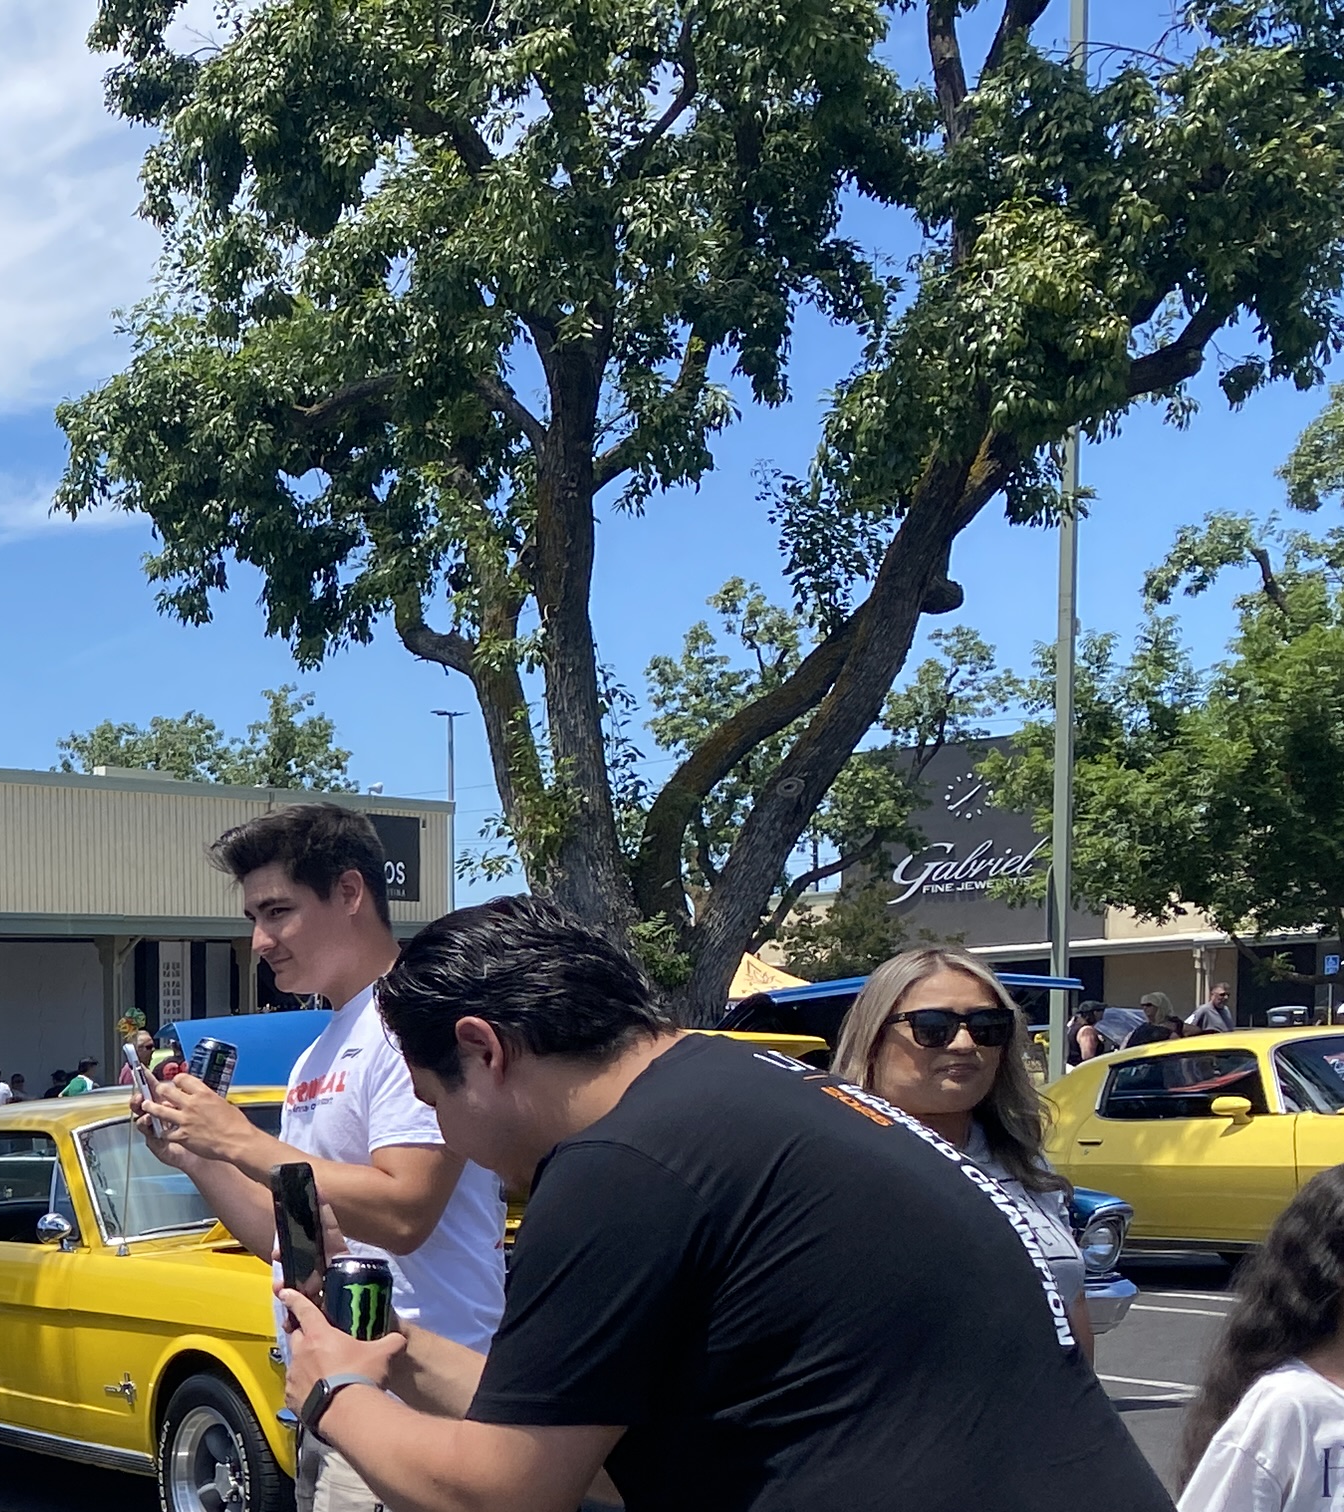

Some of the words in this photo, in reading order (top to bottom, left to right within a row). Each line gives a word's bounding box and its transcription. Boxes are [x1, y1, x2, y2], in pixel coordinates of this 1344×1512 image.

[887, 836, 1050, 904] Gabriel
[923, 883, 954, 894] FINE
[838, 1084, 962, 1161] WORLD
[961, 1165, 1075, 1346] CHAMPION
